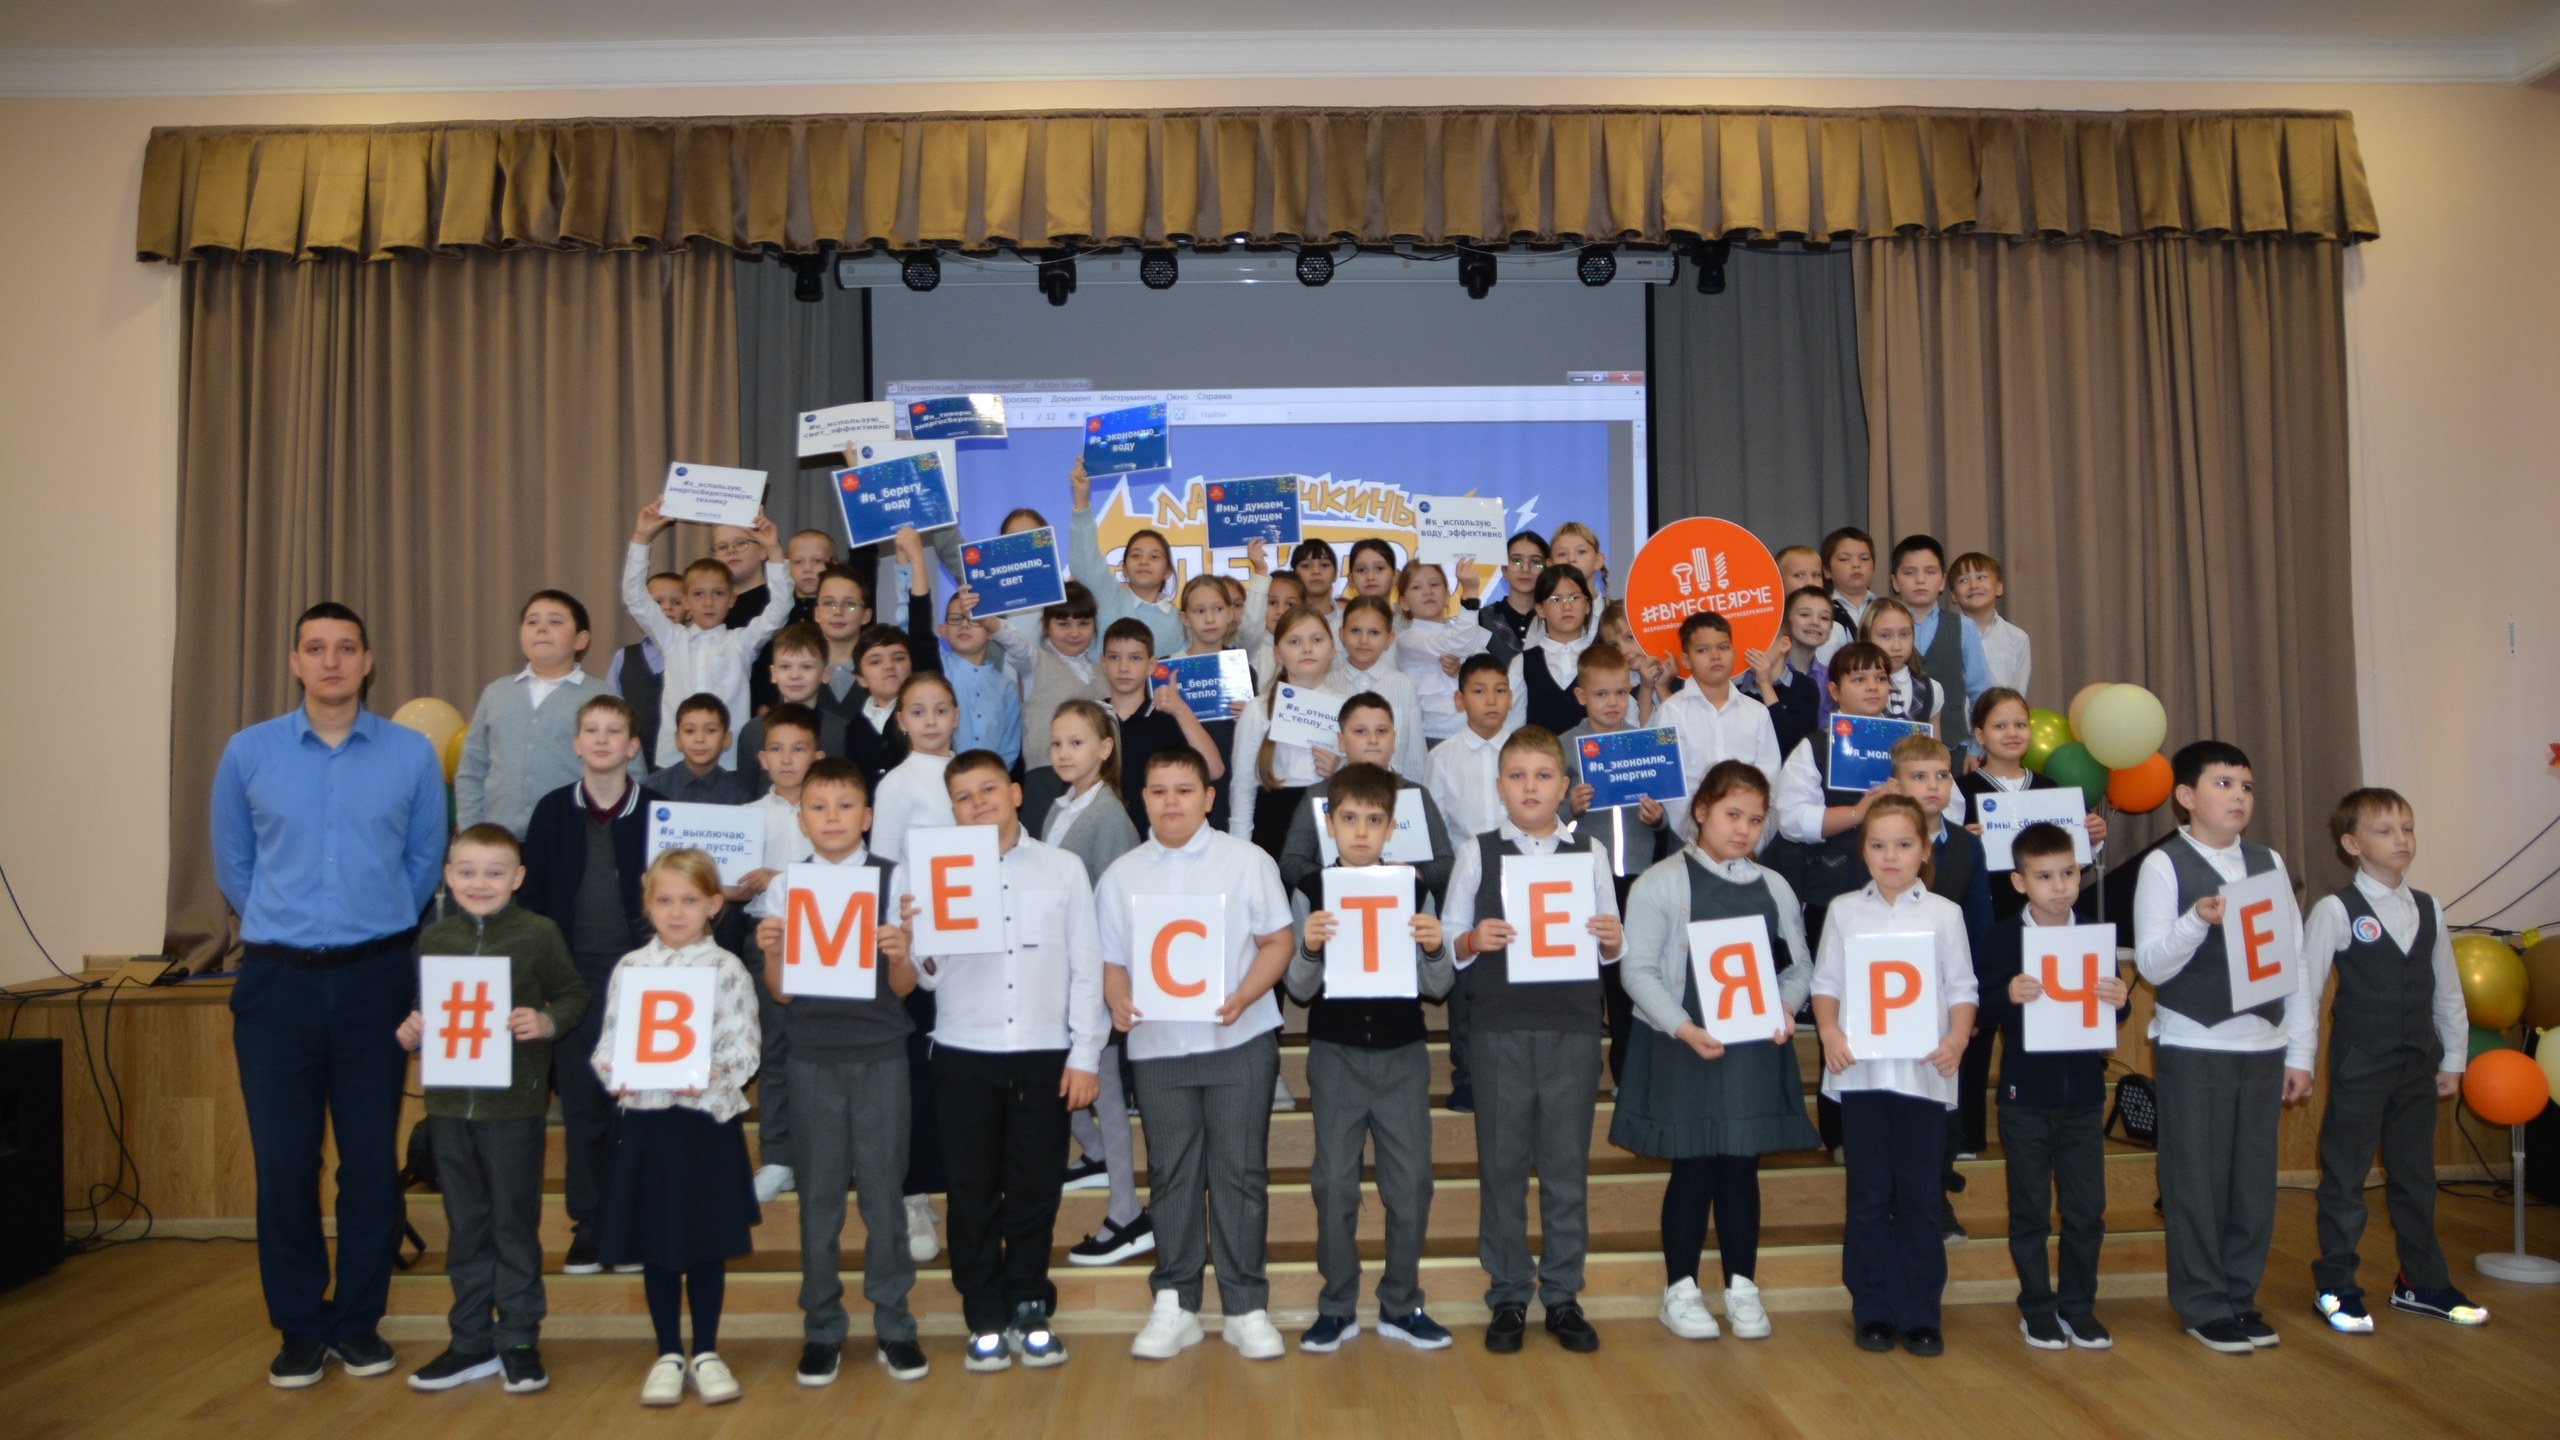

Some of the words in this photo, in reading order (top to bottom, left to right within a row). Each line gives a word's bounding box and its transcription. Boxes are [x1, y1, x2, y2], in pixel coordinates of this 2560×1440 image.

[1034, 381, 1060, 390] Adobe
[1051, 394, 1092, 403] Документ
[1101, 394, 1157, 402] Инструменты
[1166, 392, 1188, 401] Окно
[1197, 391, 1232, 401] Справка
[1046, 412, 1056, 420] 12
[1201, 410, 1226, 419] Найти
[1090, 428, 1160, 445] #я_экономлю_
[1112, 442, 1135, 452] воду
[861, 483, 931, 504] #я_берегу_
[884, 498, 911, 511] воду
[1215, 501, 1291, 513] #мы_думаем_
[1224, 513, 1283, 526] о_будущем
[1425, 517, 1497, 529] #я_использую_
[1421, 528, 1503, 539] воду_эффективно
[971, 558, 1051, 579] #я_экономлю_
[1000, 575, 1024, 587] свет
[1641, 585, 1772, 623] #ВМЕСТЕЯРЧЕ
[1186, 689, 1217, 700] тепло
[1589, 755, 1674, 772] #я_экономлю_
[1609, 768, 1657, 783] энергию
[660, 826, 753, 842] #я_выключаю_
[931, 854, 979, 931] Е
[1529, 881, 1577, 958] Е
[786, 888, 877, 969] М
[1340, 895, 1399, 973] Т
[2240, 898, 2282, 983] Е
[1150, 919, 1208, 998] С
[1709, 942, 1767, 1020] Я
[1869, 960, 1923, 1036] Р
[2041, 952, 2100, 1029] Ч
[440, 981, 494, 1060] #
[636, 990, 698, 1064] В
